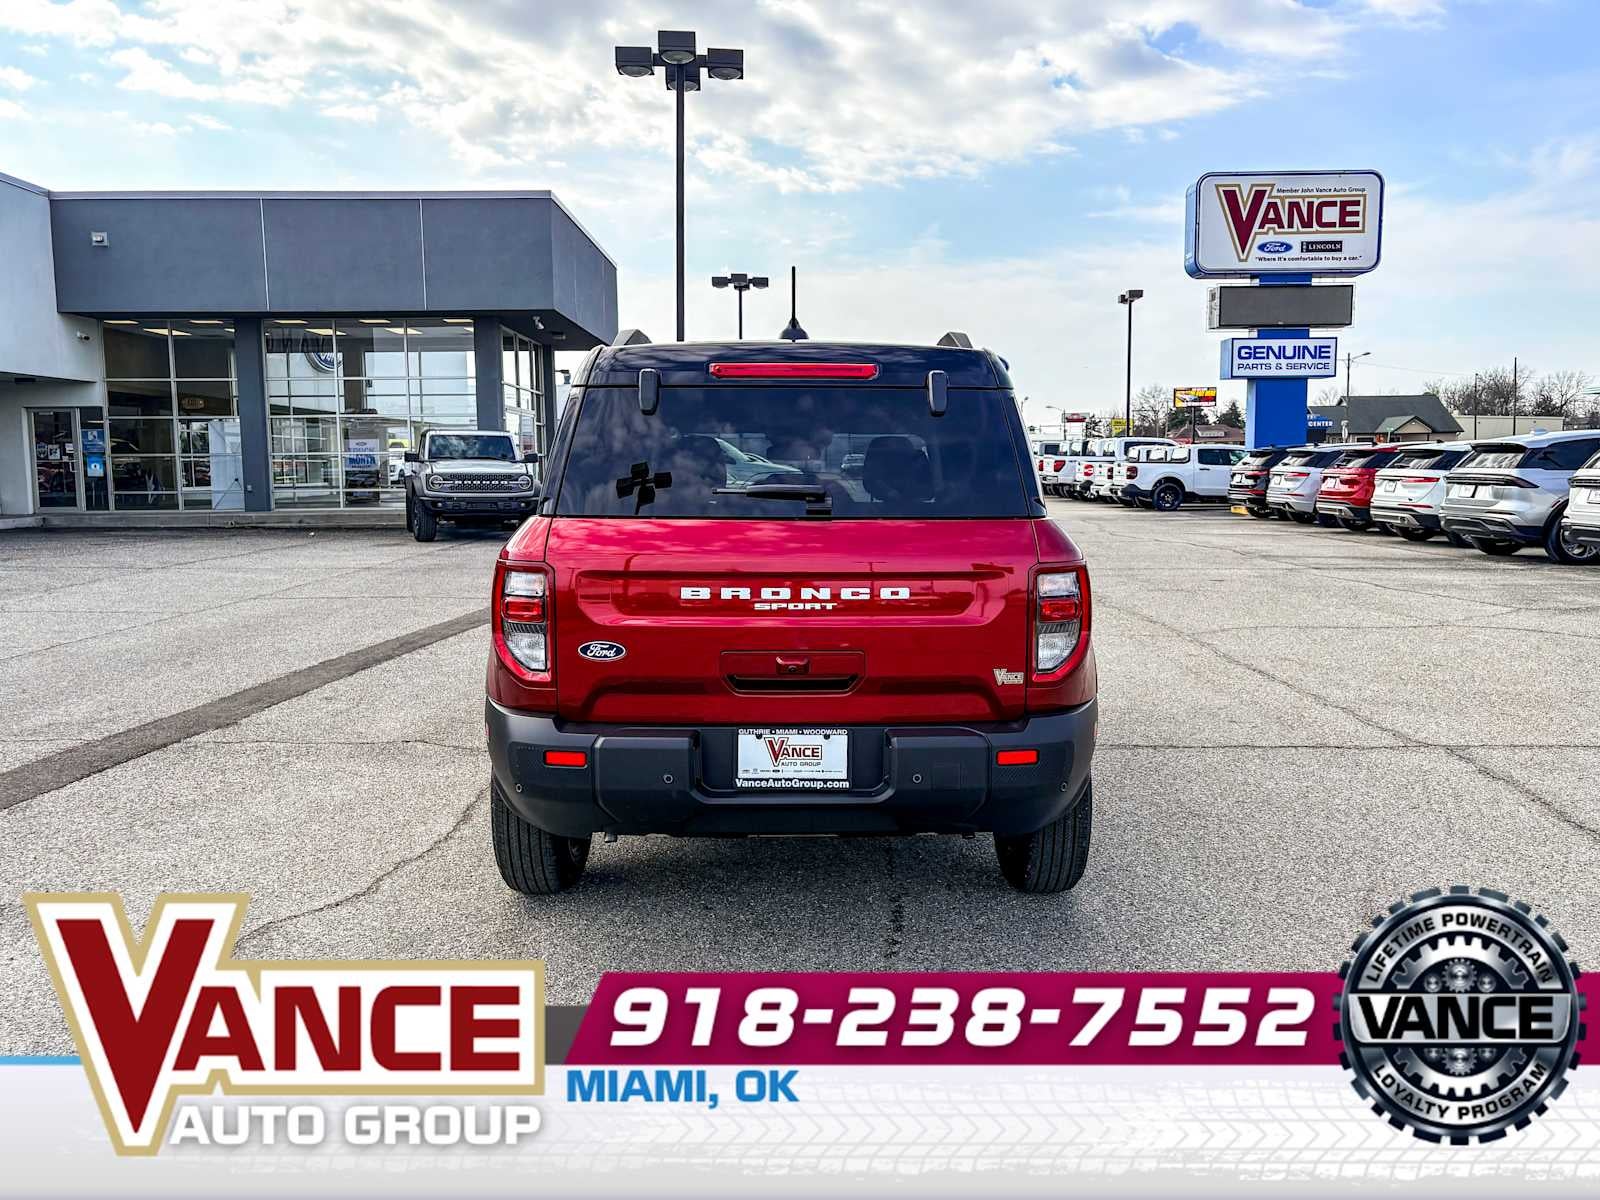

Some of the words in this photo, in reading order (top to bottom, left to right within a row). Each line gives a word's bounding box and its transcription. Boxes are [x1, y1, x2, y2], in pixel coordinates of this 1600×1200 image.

[1220, 188, 1362, 256] VANCE
[1263, 242, 1287, 252] Ford
[1237, 345, 1332, 360] GENUINE
[1237, 363, 1272, 371] PARTS
[1285, 362, 1331, 370] SERVICE
[680, 587, 911, 600] BRONCO
[753, 602, 838, 611] SPORT
[586, 643, 617, 657] Ford
[766, 738, 821, 765] VANCE
[735, 778, 850, 790] VanceAutoGroup.com
